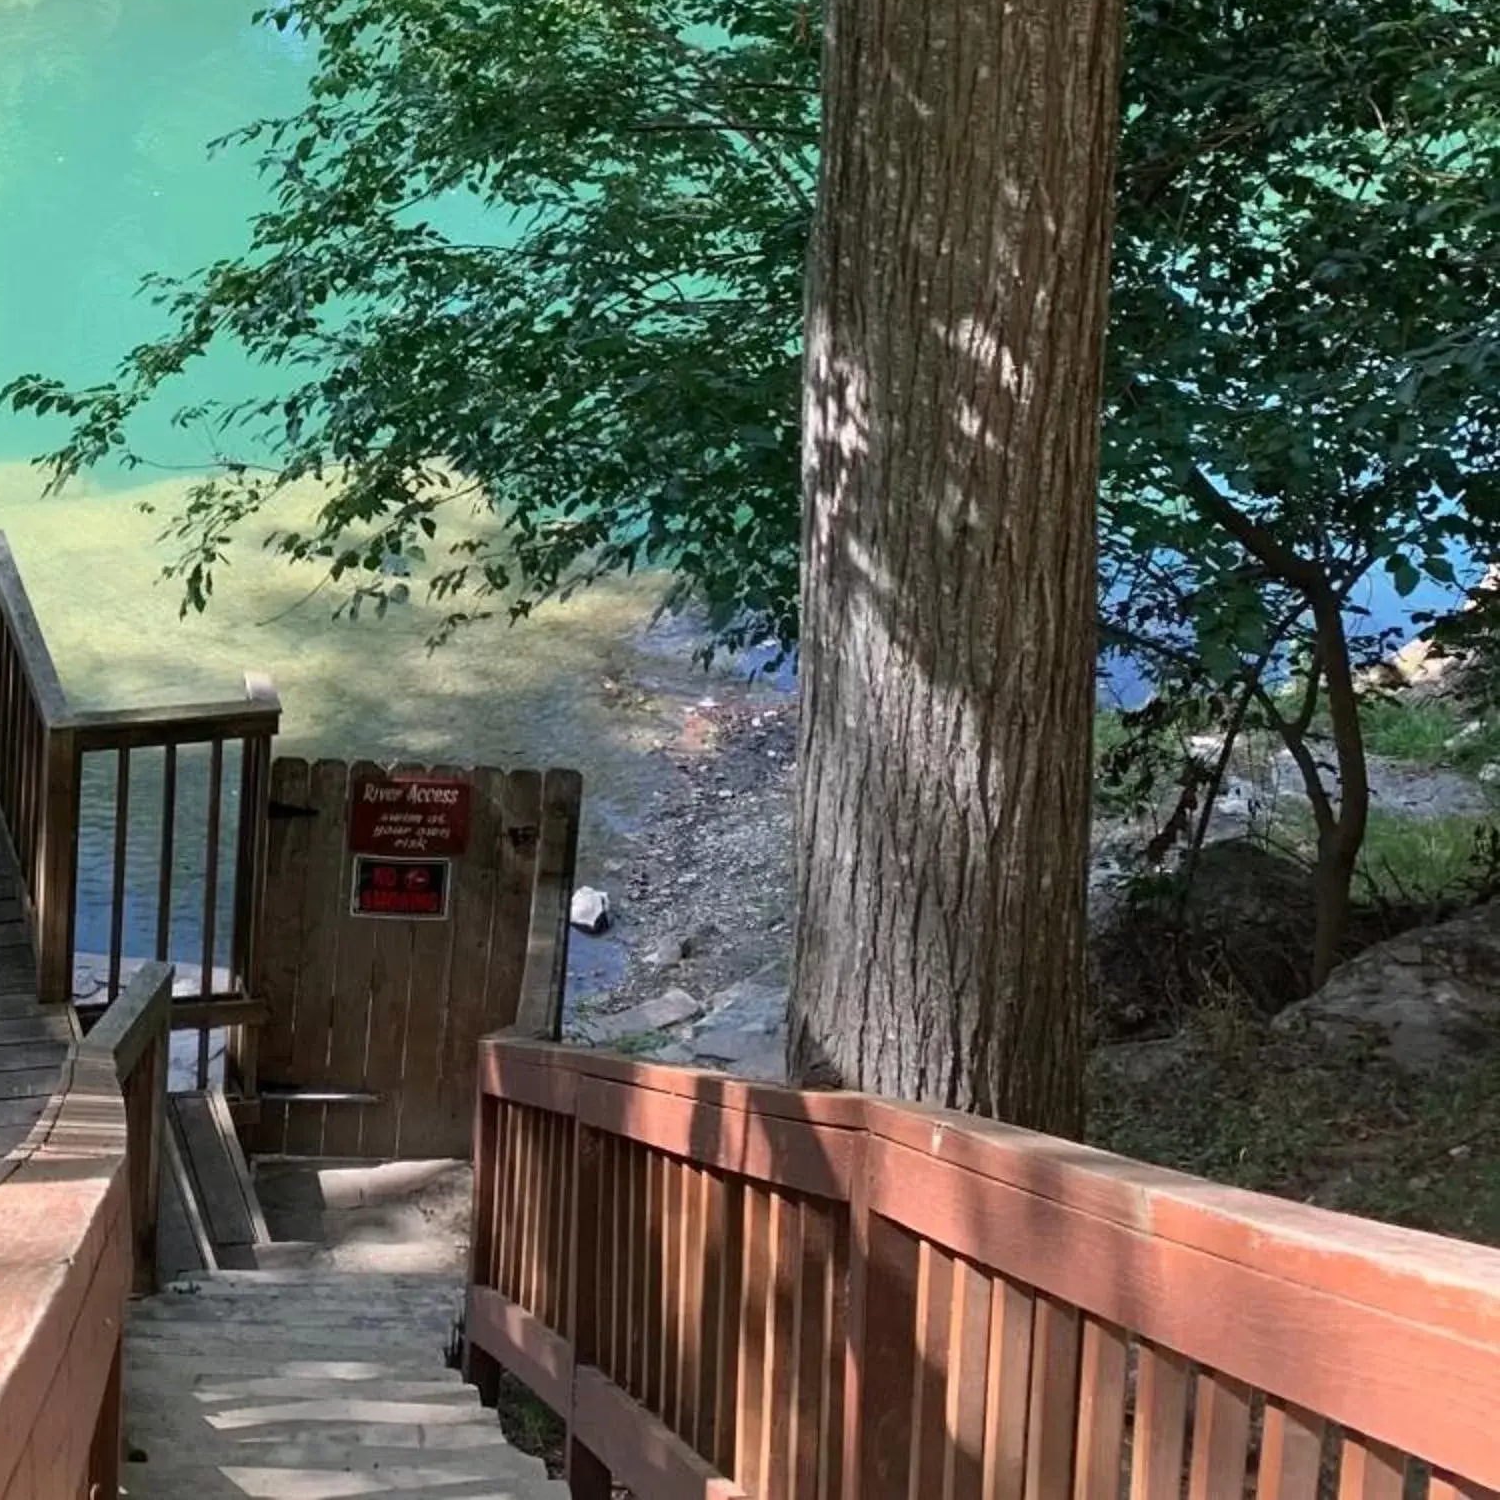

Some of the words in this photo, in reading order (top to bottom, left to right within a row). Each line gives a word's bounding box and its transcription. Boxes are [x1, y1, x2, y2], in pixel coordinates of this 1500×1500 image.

[363, 783, 403, 802] River
[407, 784, 459, 804] Access
[394, 838, 428, 850] risk
